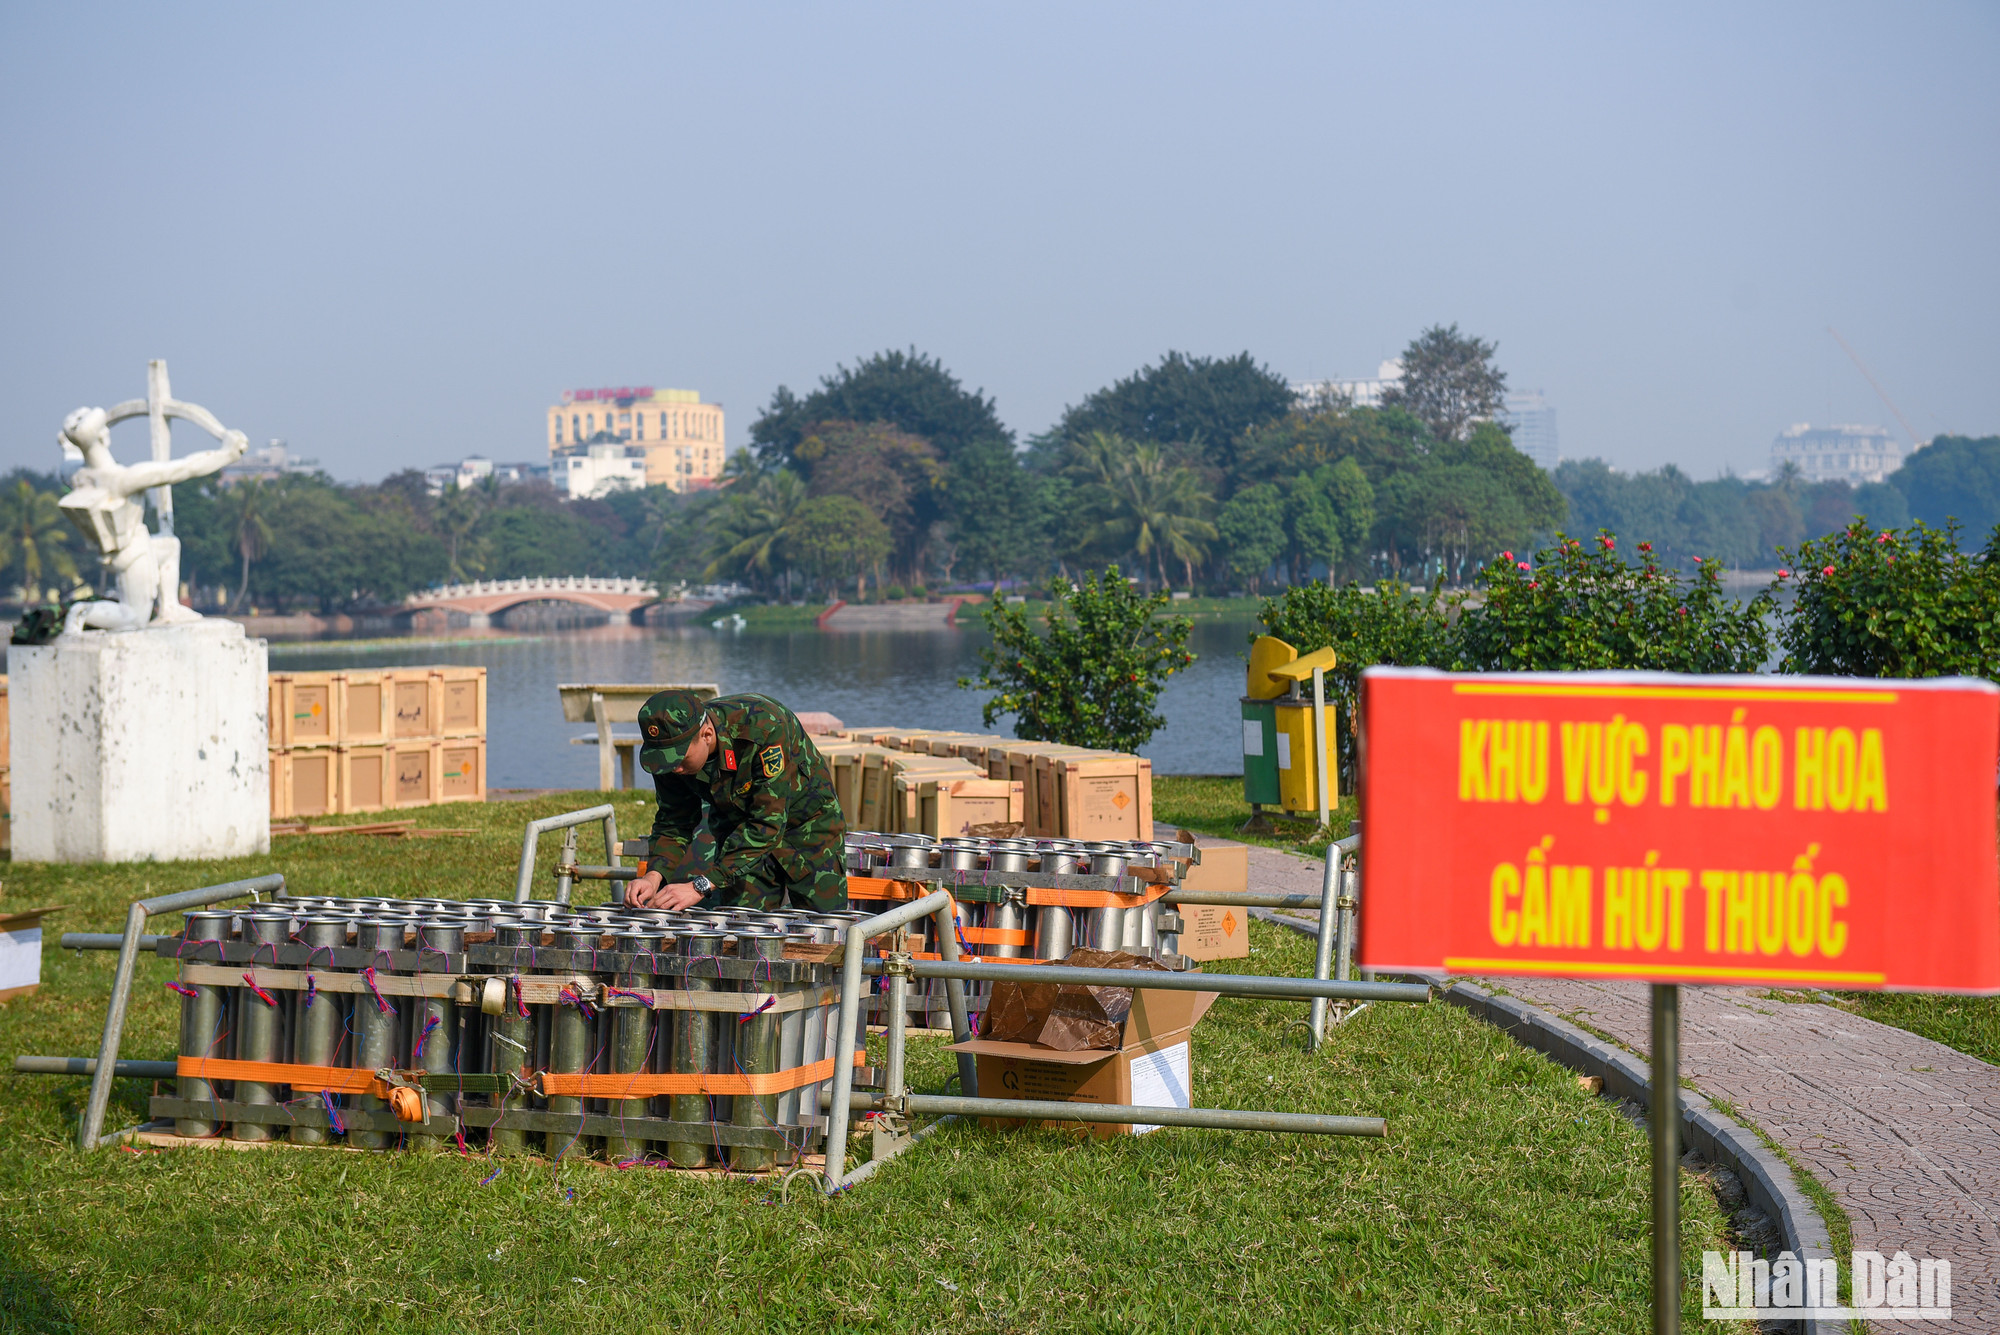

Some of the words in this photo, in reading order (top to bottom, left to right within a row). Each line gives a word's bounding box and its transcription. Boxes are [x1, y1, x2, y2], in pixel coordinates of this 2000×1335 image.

[1459, 719, 1549, 803] KHU
[1560, 714, 1649, 824] VỰC
[1660, 708, 1783, 811] PHÁO
[1794, 726, 1888, 813] HOA
[1490, 835, 1592, 949] CẤM
[1603, 850, 1691, 952] HÚT
[1700, 843, 1848, 958] THUỐC
